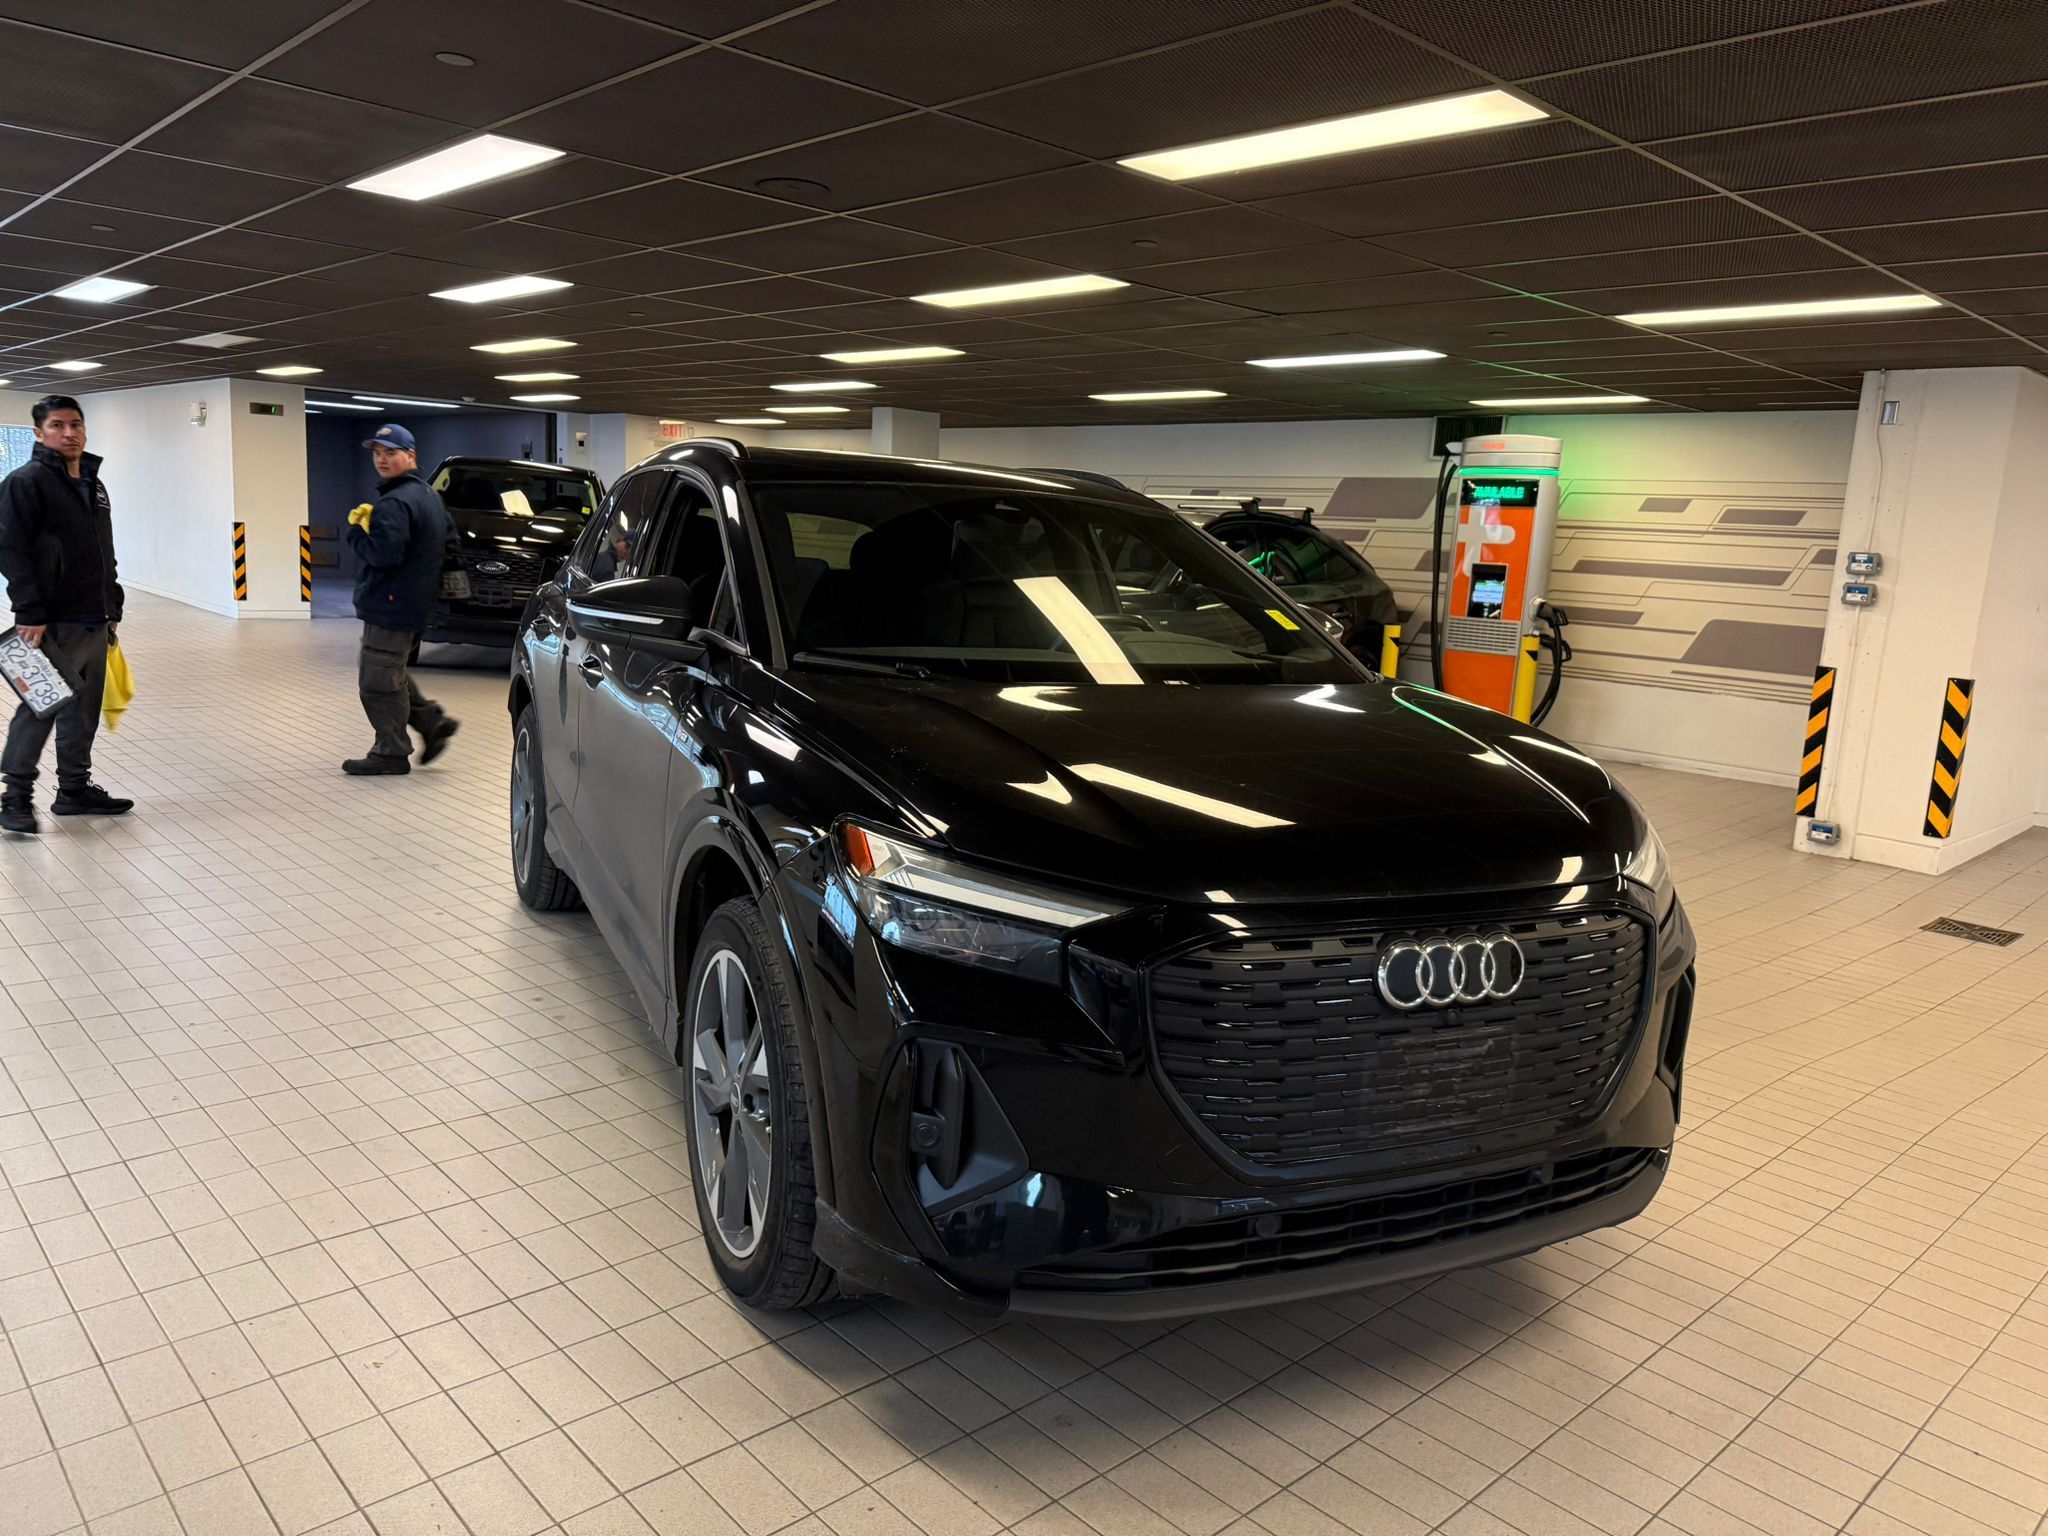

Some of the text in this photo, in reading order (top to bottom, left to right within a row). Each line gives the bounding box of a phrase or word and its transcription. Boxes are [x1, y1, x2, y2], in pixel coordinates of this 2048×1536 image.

[661, 423, 685, 437] EXIT
[1473, 486, 1525, 499] AVAILABLE
[1, 638, 28, 664] R2
[22, 665, 60, 706] 3738
